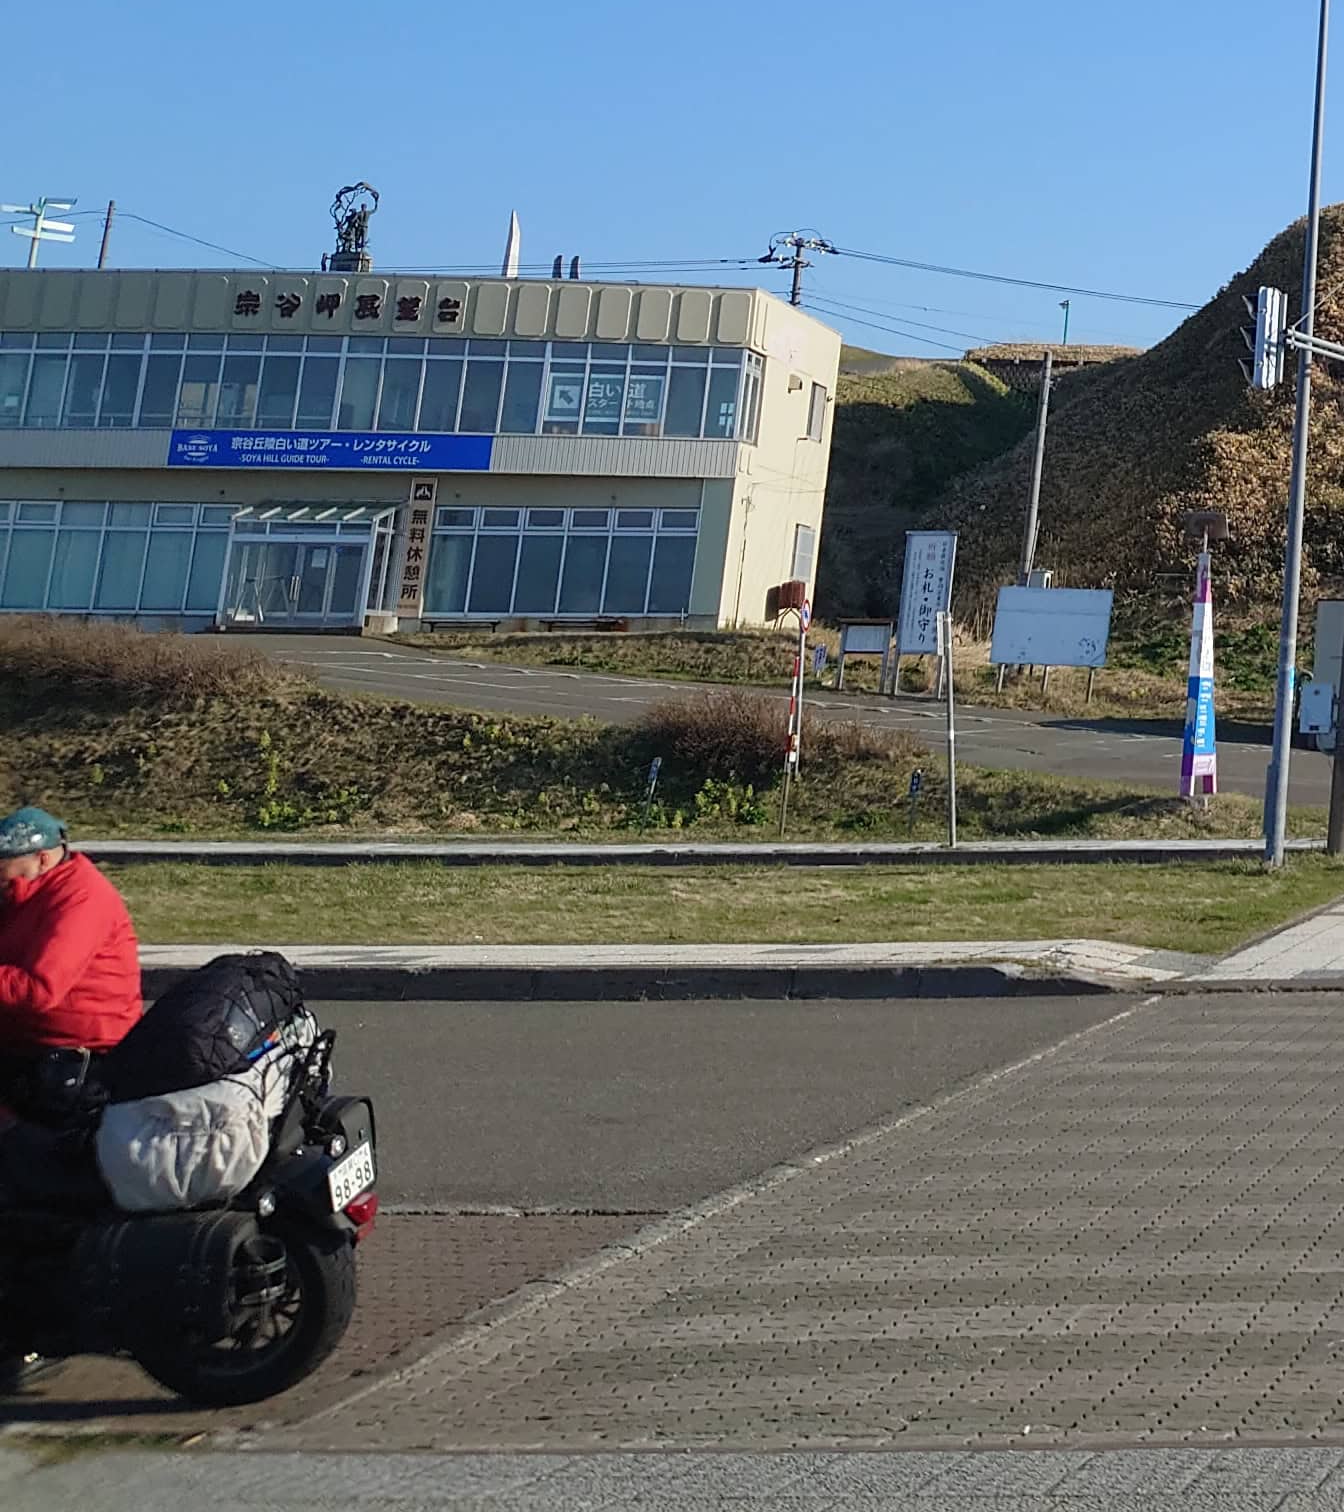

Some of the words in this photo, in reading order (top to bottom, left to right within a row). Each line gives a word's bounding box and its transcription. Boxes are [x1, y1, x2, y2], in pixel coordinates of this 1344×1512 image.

[234, 290, 460, 323] 宗谷岬展望台
[588, 382, 646, 398] 白い道
[263, 454, 280, 463] HILL
[281, 454, 304, 463] GUIDE
[401, 510, 429, 600] 無料休憩所
